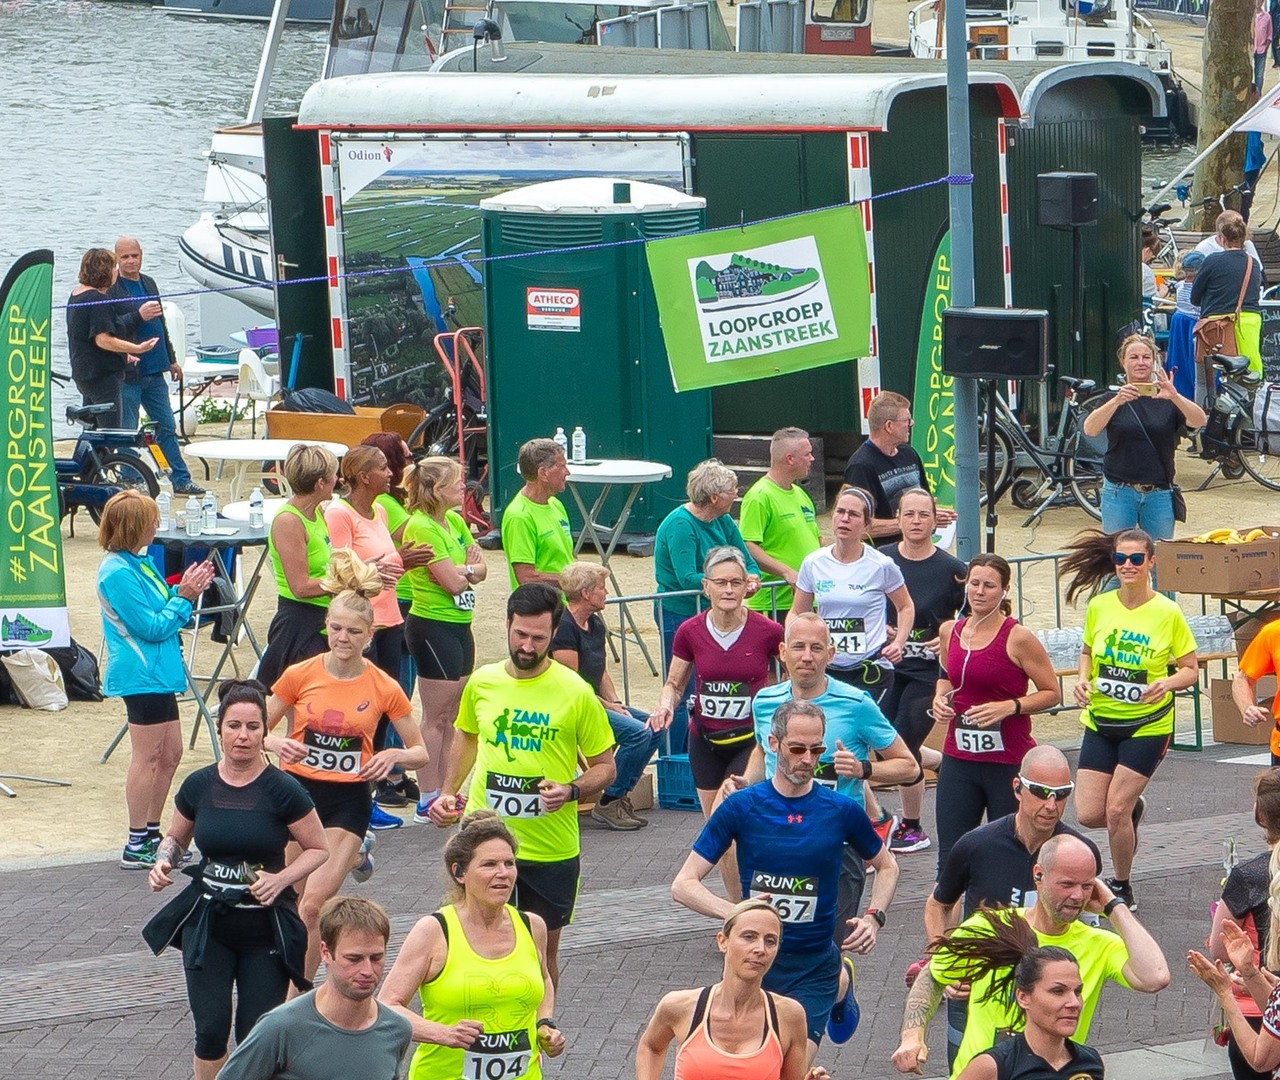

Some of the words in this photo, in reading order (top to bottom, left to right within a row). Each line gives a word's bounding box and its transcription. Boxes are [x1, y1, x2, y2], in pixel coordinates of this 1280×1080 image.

[348, 151, 382, 161] Odion
[533, 295, 574, 305] ATHECO
[708, 301, 824, 337] LOOPGROEP
[709, 319, 835, 358] ZAANSTREEK
[7, 303, 28, 585] #LOOPGROEP
[28, 317, 59, 575] ZAANSTREEK
[831, 635, 861, 652] 41
[1120, 629, 1151, 645] ZAAN
[1116, 652, 1141, 666] RUN
[1117, 642, 1156, 660] BOCHT
[1107, 666, 1142, 680] RUNX
[705, 682, 742, 695] RUNX
[1101, 681, 1142, 701] 280
[512, 709, 550, 726] ZAAN
[705, 699, 746, 717] 977
[314, 732, 355, 750] RUNX
[510, 724, 559, 742] BOCHT
[961, 732, 996, 751] 518
[511, 738, 542, 752] RUN
[305, 749, 355, 772] 590
[495, 774, 540, 793] RUNX
[489, 793, 542, 817] 704
[214, 864, 250, 883] RUN
[762, 874, 813, 894] RUNX
[771, 897, 812, 921] 67
[478, 1031, 522, 1050] RUNX
[472, 1055, 522, 1080] 104
